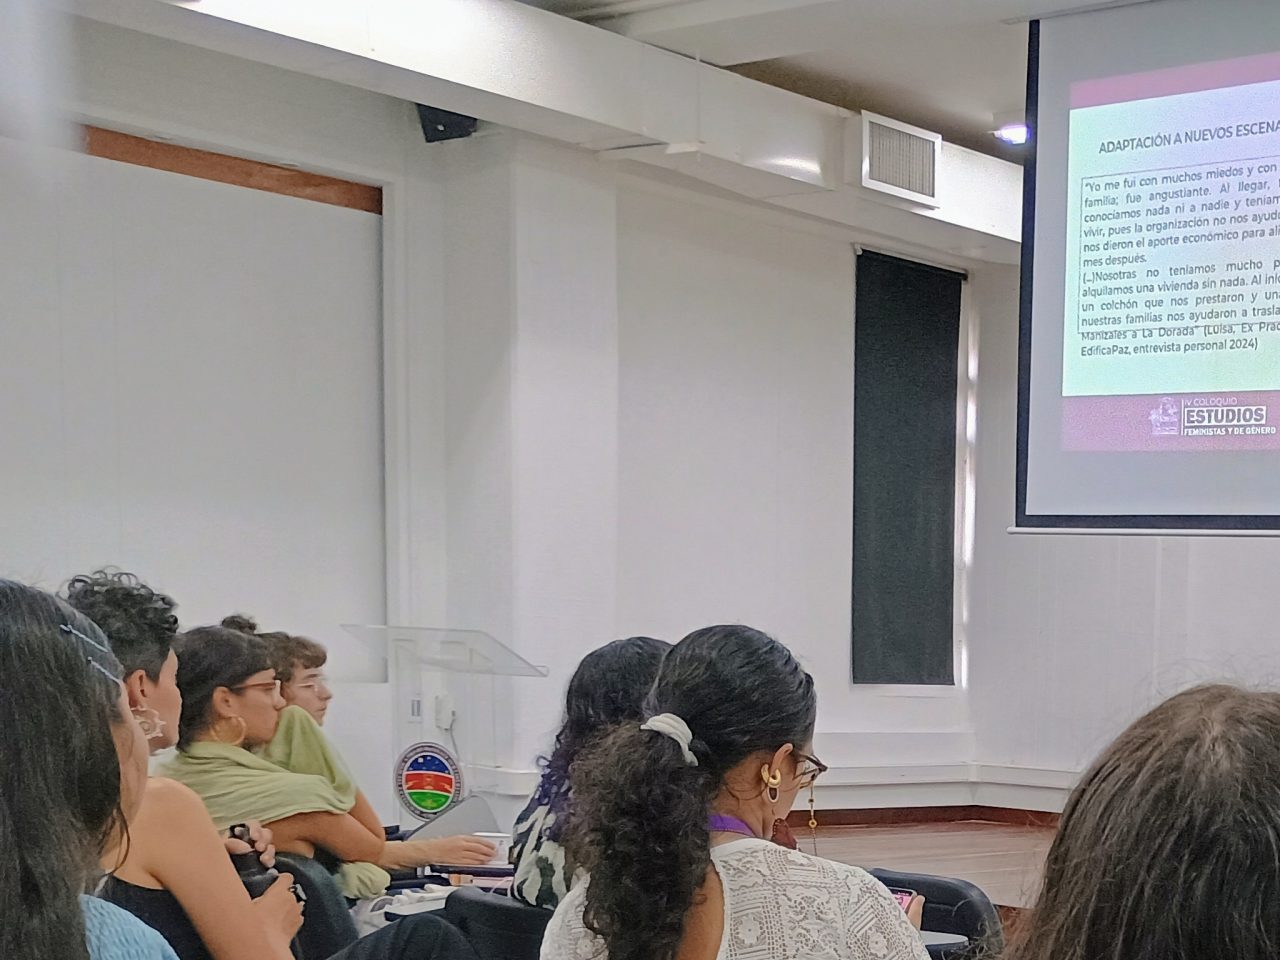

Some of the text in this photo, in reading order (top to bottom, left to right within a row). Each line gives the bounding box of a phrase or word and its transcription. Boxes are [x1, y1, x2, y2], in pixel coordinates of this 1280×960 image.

[1099, 132, 1172, 154] ADAPTACIÓN
[1173, 132, 1183, 144] A
[1185, 126, 1233, 143] NUEVOS
[1104, 181, 1120, 191] me
[1124, 177, 1136, 188] fui
[1140, 177, 1158, 187] con
[1161, 171, 1202, 185] muchos
[1206, 166, 1244, 180] miedos
[1246, 167, 1254, 177] y
[1258, 164, 1277, 174] con
[1126, 193, 1142, 204] fue
[1149, 186, 1212, 203] angustiante.
[1220, 182, 1230, 194] Al
[1238, 180, 1271, 194] llegar,
[1146, 204, 1170, 217] nada
[1175, 202, 1185, 214] ni
[1190, 204, 1196, 213] a
[1202, 199, 1230, 212] nadie
[1233, 200, 1241, 211] y
[1084, 226, 1105, 238] vivir,
[1108, 226, 1131, 238] pues
[1134, 223, 1143, 233] la
[1213, 217, 1227, 227] no
[1230, 214, 1249, 224] nos
[1083, 243, 1101, 253] nos
[1103, 240, 1133, 252] dieron
[1136, 237, 1145, 248] el
[1147, 236, 1180, 249] aporte
[1241, 229, 1265, 241] para
[1083, 258, 1103, 267] mes
[1146, 269, 1159, 278] no
[1226, 260, 1263, 272] mucho
[1082, 285, 1134, 299] alquilamos
[1136, 284, 1154, 294] una
[1157, 279, 1199, 292] vivienda
[1202, 277, 1217, 289] sin
[1219, 276, 1248, 288] nada.
[1251, 275, 1262, 286] Al
[1082, 302, 1095, 312] un
[1100, 298, 1138, 311] colchón
[1144, 299, 1164, 311] que
[1170, 297, 1189, 307] nos
[1195, 293, 1244, 307] prestaron
[1251, 292, 1258, 303] y
[1081, 316, 1122, 327] nuestras
[1125, 312, 1163, 325] familias
[1167, 311, 1185, 322] nos
[1189, 308, 1237, 324] ayudaron
[1241, 308, 1248, 317] a
[1131, 330, 1137, 339] a
[1142, 328, 1153, 338] La
[1081, 337, 1258, 357] EdificaPaz, entrevista personal 2024)
[1193, 397, 1238, 407] COLOQUIO
[1186, 407, 1265, 424] ESTUDIOS
[1227, 427, 1233, 435] Y
[1234, 427, 1245, 435] DE
